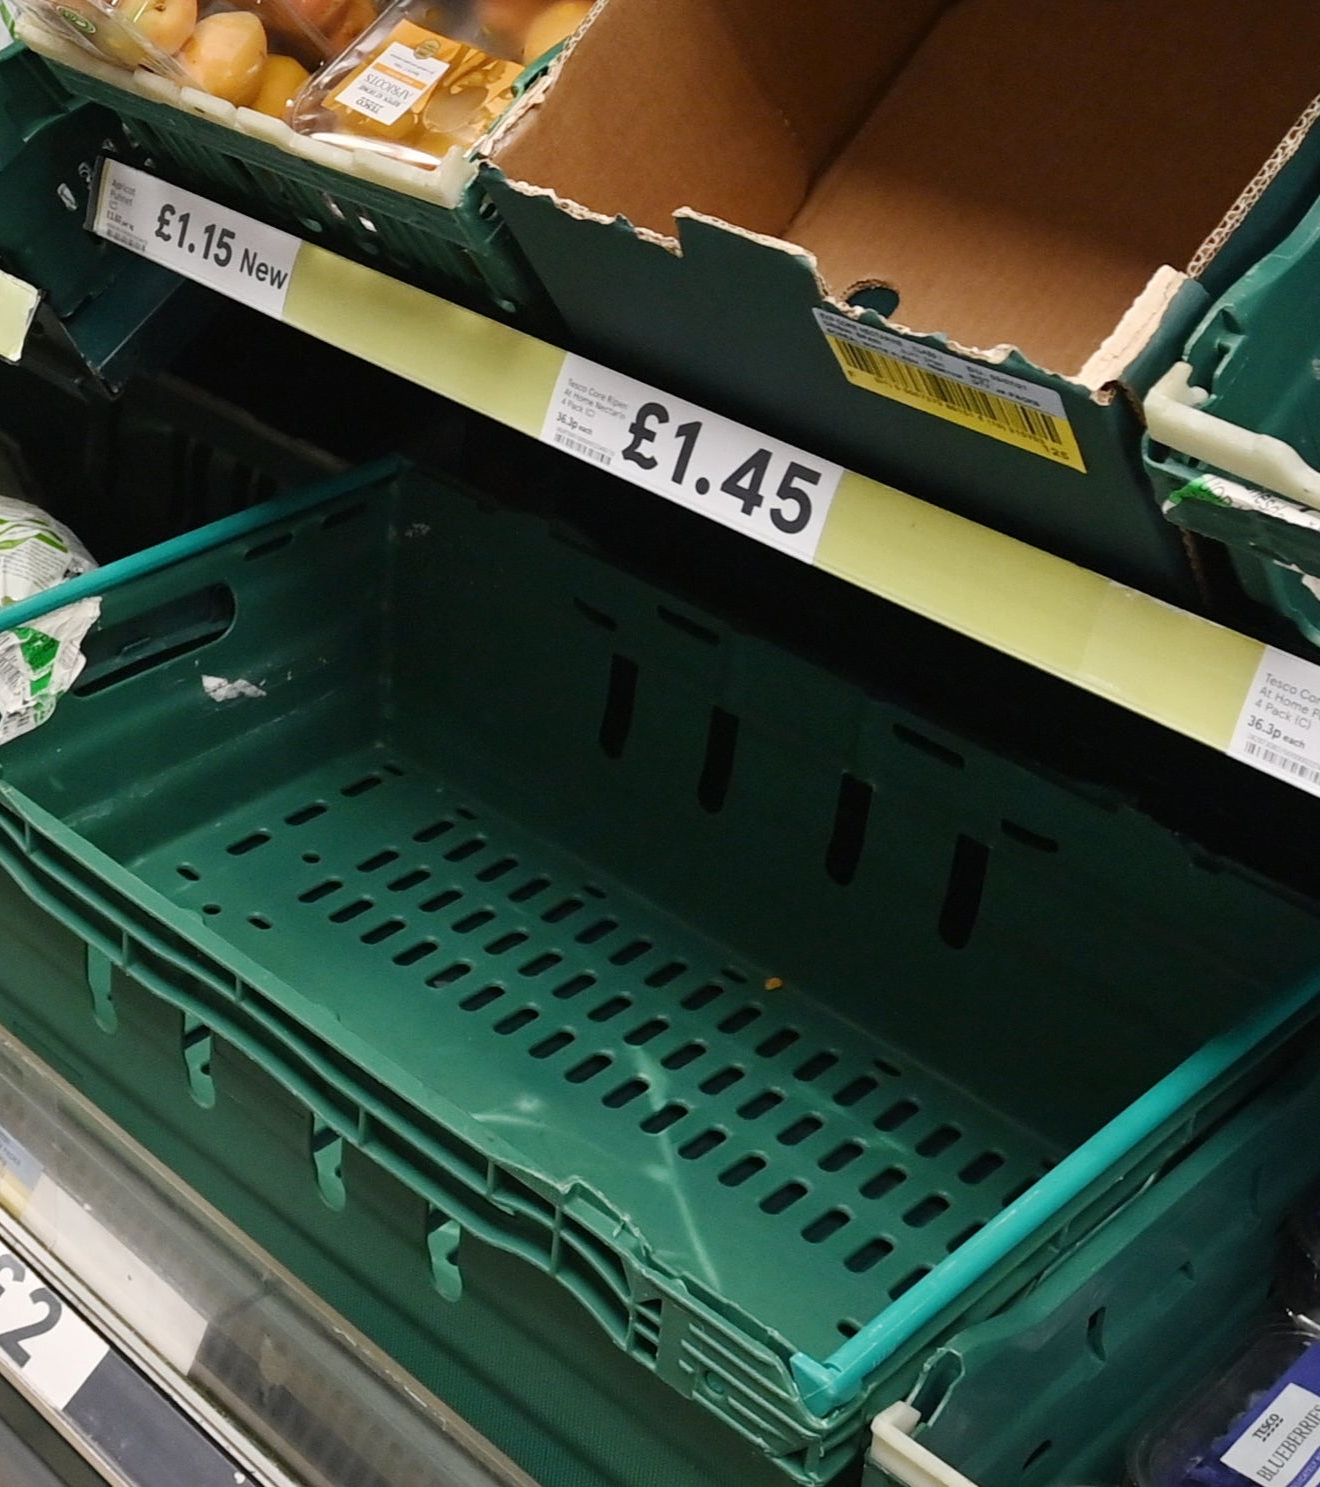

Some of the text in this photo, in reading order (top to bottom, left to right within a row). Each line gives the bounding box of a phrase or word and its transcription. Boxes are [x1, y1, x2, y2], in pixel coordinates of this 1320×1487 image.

[355, 98, 382, 114] TESCO
[153, 202, 290, 291] £1.15 New
[620, 400, 823, 536] £1.45
[1265, 672, 1298, 696] Tesco
[1254, 698, 1264, 709] 4
[1264, 702, 1293, 722] Pack
[1259, 686, 1273, 699] At
[1274, 692, 1310, 715] Home
[1246, 714, 1307, 750] 36.3p each
[1250, 1412, 1282, 1443] TESCO
